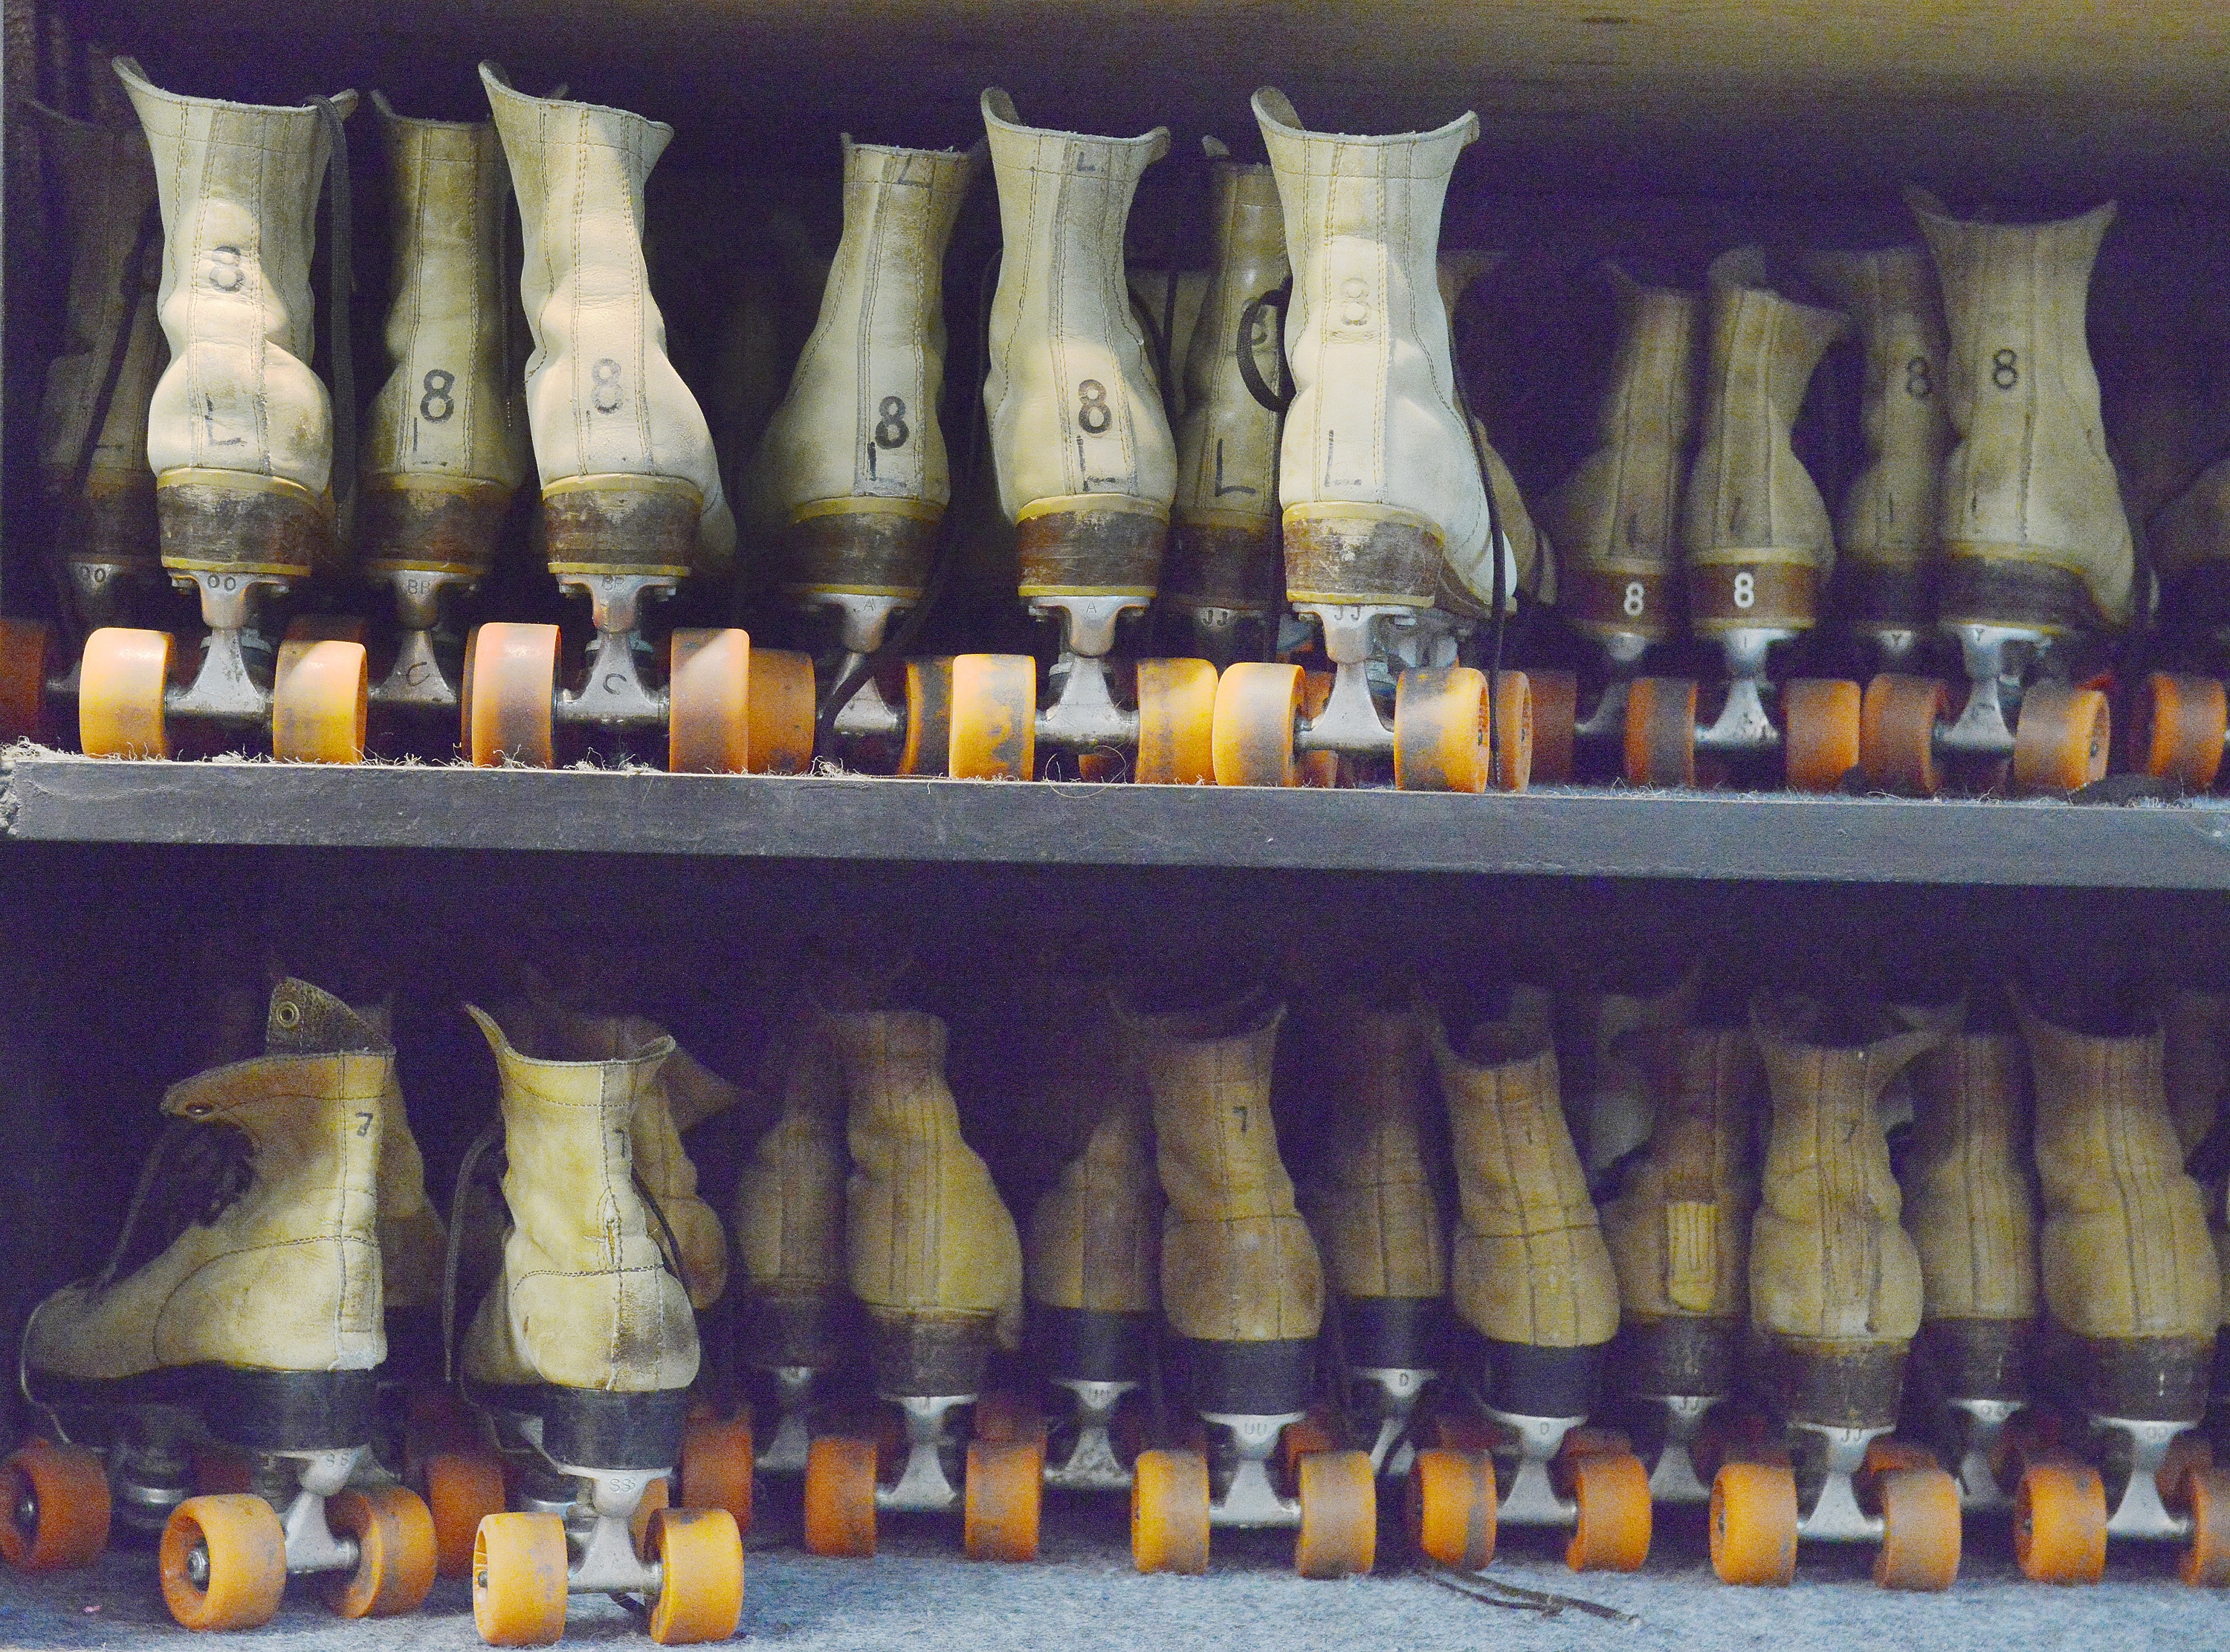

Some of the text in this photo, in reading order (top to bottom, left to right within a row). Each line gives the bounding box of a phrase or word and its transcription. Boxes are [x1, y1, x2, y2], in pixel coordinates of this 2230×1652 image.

[1077, 151, 1096, 172] L
[210, 246, 245, 294] 8
[1339, 277, 1370, 326] 8
[1905, 356, 1933, 401] 8
[1992, 349, 2017, 389] 8
[421, 369, 456, 422] 8
[592, 358, 624, 414] 8
[1079, 379, 1112, 433] 8
[875, 396, 909, 450] 8
[1215, 438, 1256, 497] L
[864, 598, 875, 611] A
[1623, 581, 1644, 617] 8
[1734, 571, 1755, 609] 8
[1086, 601, 1097, 614] A
[1202, 608, 1228, 626] JJ
[1334, 605, 1360, 621] JJ
[1975, 628, 1985, 642] Y
[406, 661, 430, 687] C
[603, 673, 627, 695] C
[355, 1111, 373, 1138] 7
[1233, 1105, 1247, 1133] 7
[613, 1128, 625, 1159] 7
[1398, 1372, 1409, 1387] D
